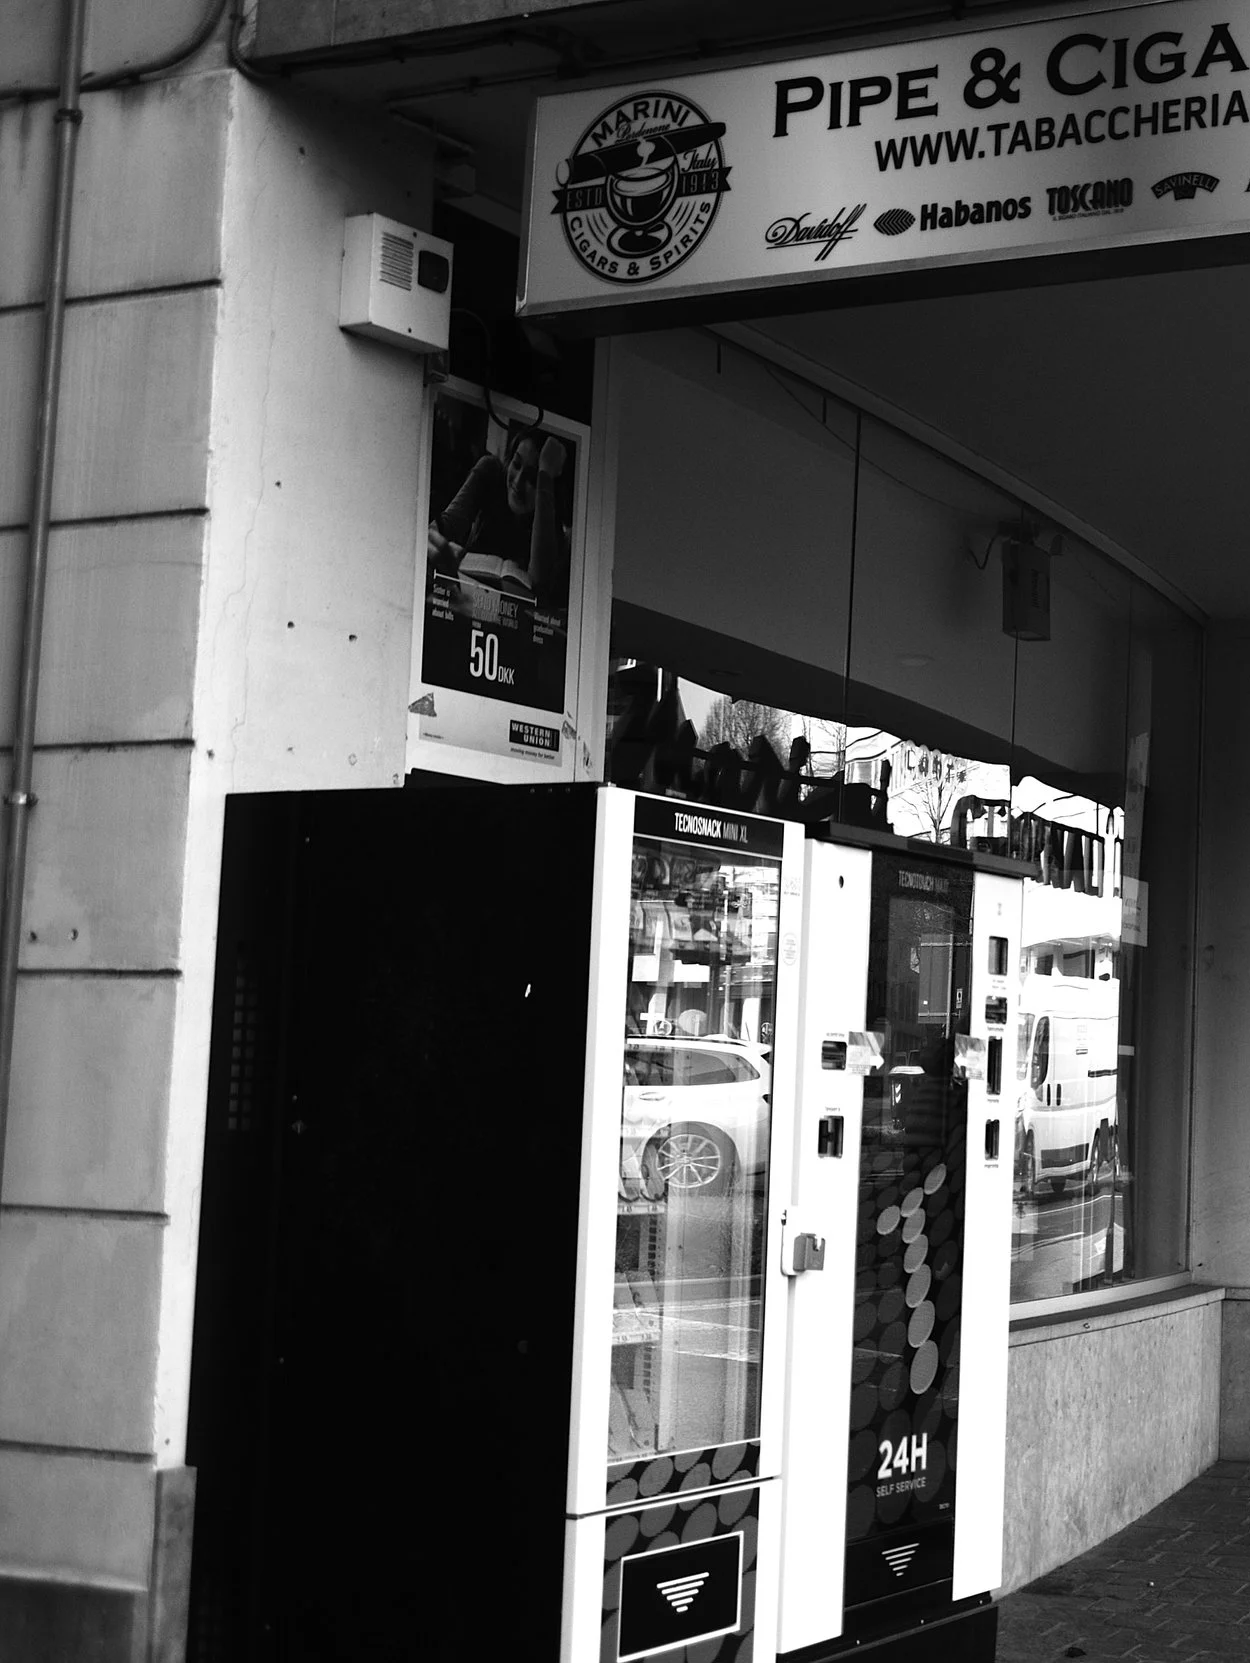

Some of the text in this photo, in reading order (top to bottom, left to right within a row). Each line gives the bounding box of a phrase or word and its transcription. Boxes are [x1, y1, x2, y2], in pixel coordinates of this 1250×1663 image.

[772, 64, 940, 138] PIPE
[963, 47, 1021, 109] &
[591, 99, 691, 148] MARINI
[681, 143, 719, 174] Italy
[1046, 178, 1134, 216] TOSCANO
[1154, 173, 1218, 196] SAVINELLI
[764, 202, 868, 262] Davidoff
[920, 196, 1032, 232] Habanos
[570, 200, 712, 277] CIGARS & SPIRITS
[469, 628, 499, 681] 50
[498, 665, 515, 686] DKK
[511, 722, 551, 738] WESTERN
[523, 734, 551, 747] UNION
[673, 811, 749, 844] TECNOSNACK MINI XL
[877, 1432, 928, 1480] 24H
[876, 1477, 926, 1497] SELF SERVICE
